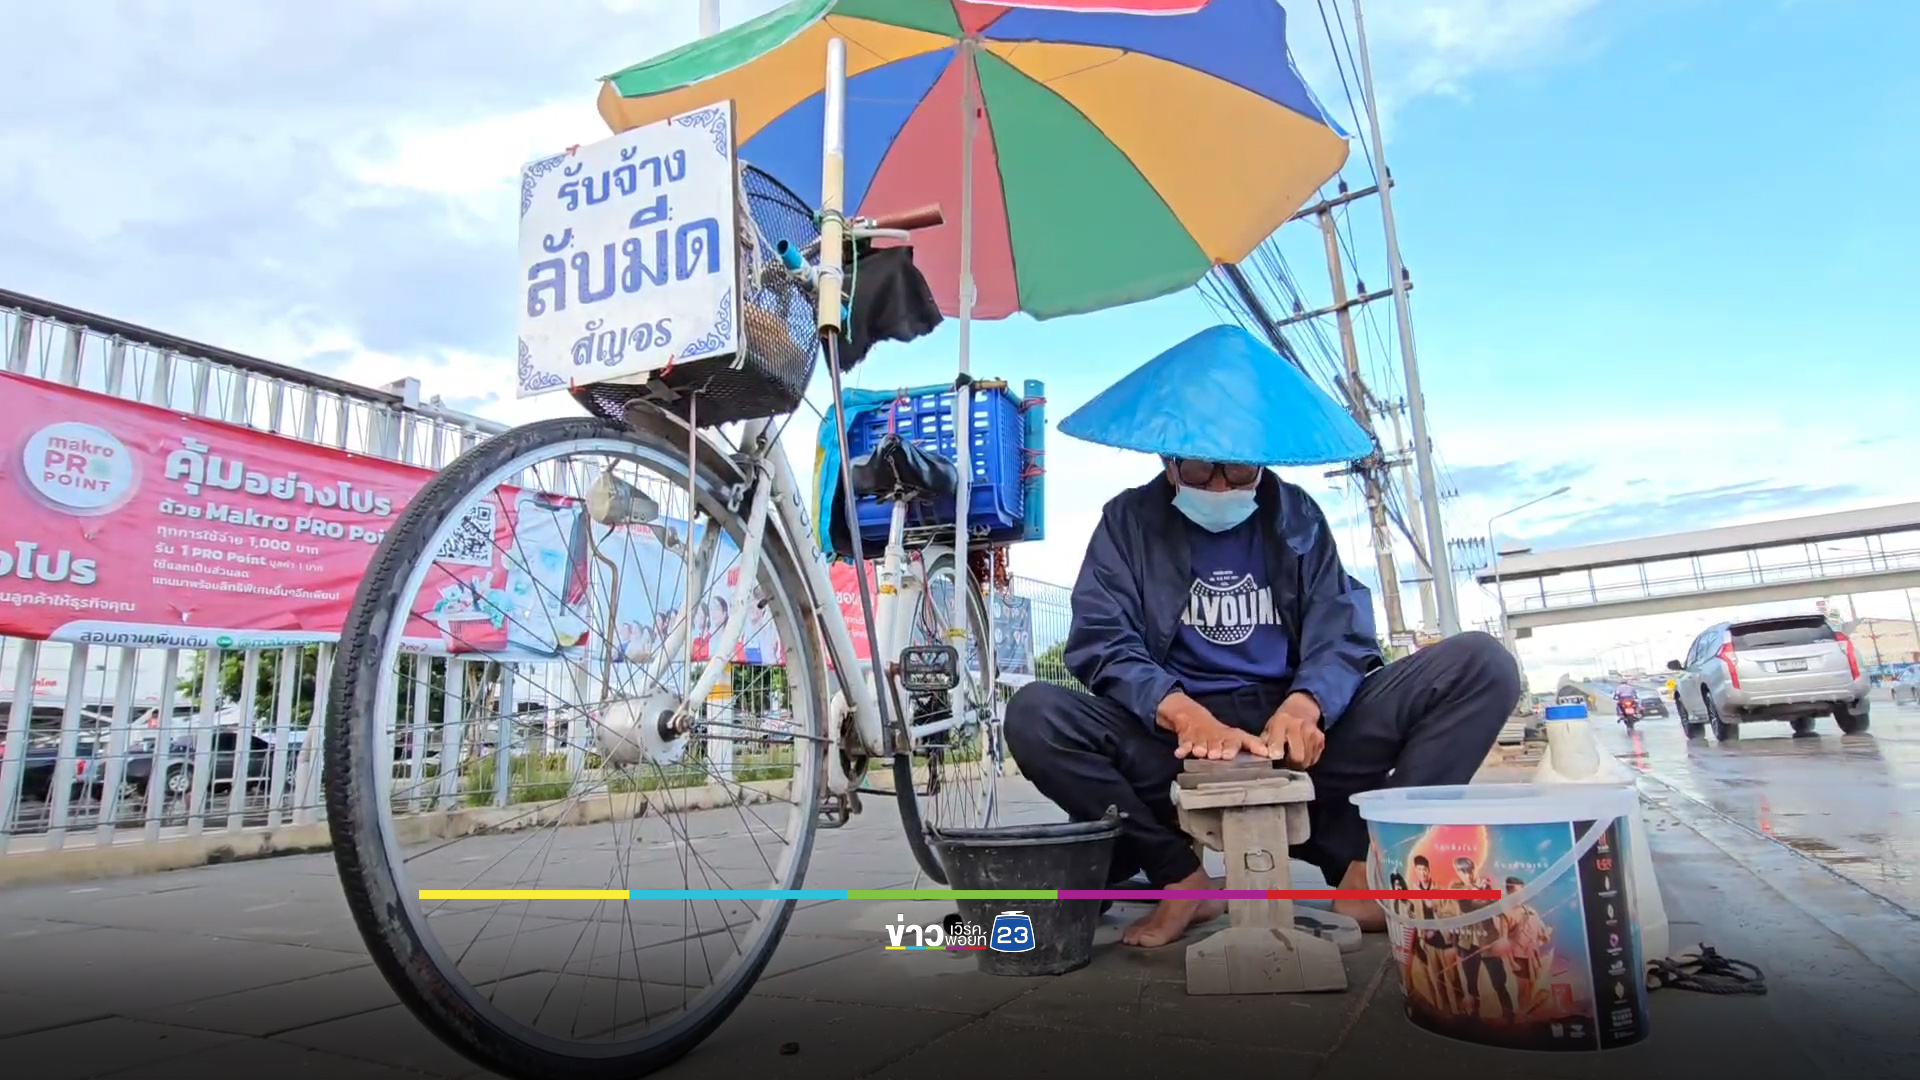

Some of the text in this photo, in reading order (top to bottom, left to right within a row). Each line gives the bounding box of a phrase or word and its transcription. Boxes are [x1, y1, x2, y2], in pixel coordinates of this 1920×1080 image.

[557, 145, 687, 211] รับจ้าง
[526, 193, 721, 318] ลับมีด
[571, 317, 672, 367] สัญจร
[48, 436, 115, 458] makro
[43, 471, 111, 492] POINT
[164, 436, 393, 517] คุ้มอย่างโปร
[156, 525, 319, 555] ทุกการใช้จ่าย 1,000 บาท
[158, 498, 386, 545] ด้วย Makro PRO Poi
[154, 542, 175, 556] รับ
[181, 543, 188, 556] 1
[192, 546, 224, 561] PRO
[227, 552, 267, 567] Point
[79, 628, 209, 649] สอบถามเพิ่มเติม
